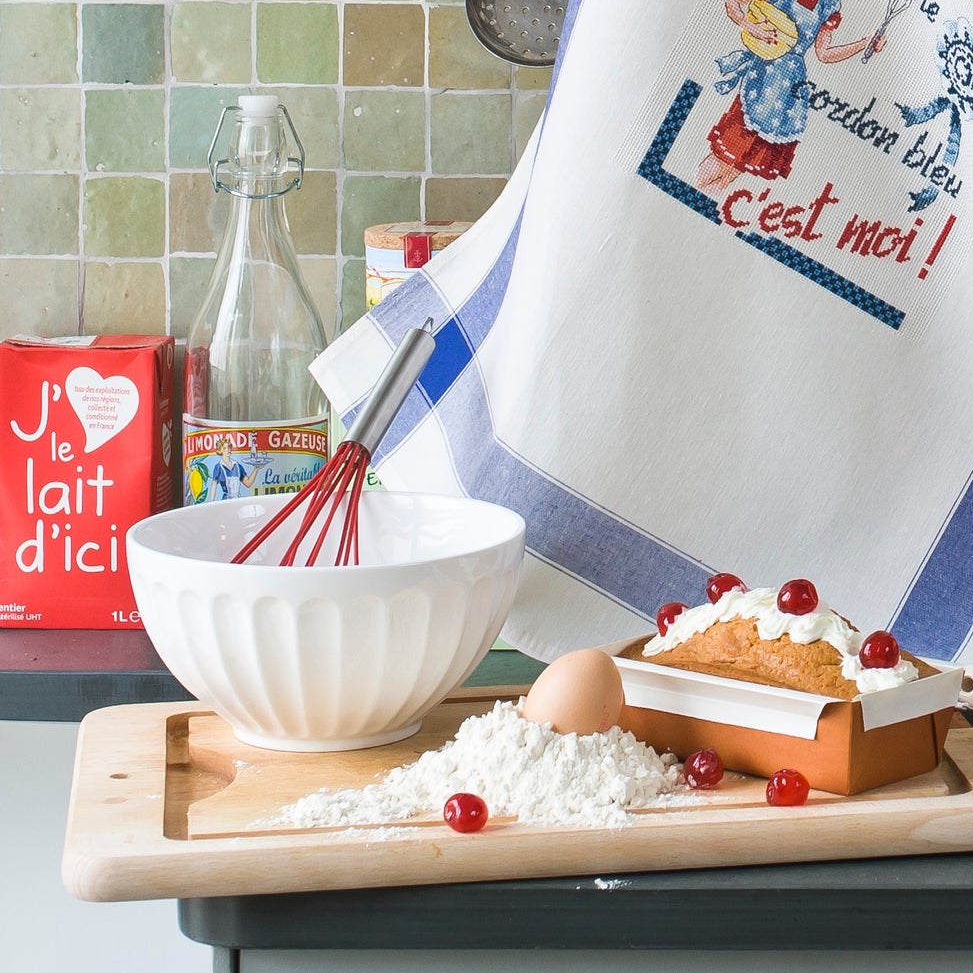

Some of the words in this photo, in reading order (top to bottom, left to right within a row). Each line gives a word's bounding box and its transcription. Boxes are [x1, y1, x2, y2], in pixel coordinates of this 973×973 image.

[902, 131, 963, 199] bleu
[721, 182, 839, 242] c'est
[51, 431, 75, 462] le
[268, 429, 326, 453] GAZEUSE
[26, 457, 115, 517] lait
[15, 519, 119, 573] d'ici
[25, 613, 42, 621] UHT
